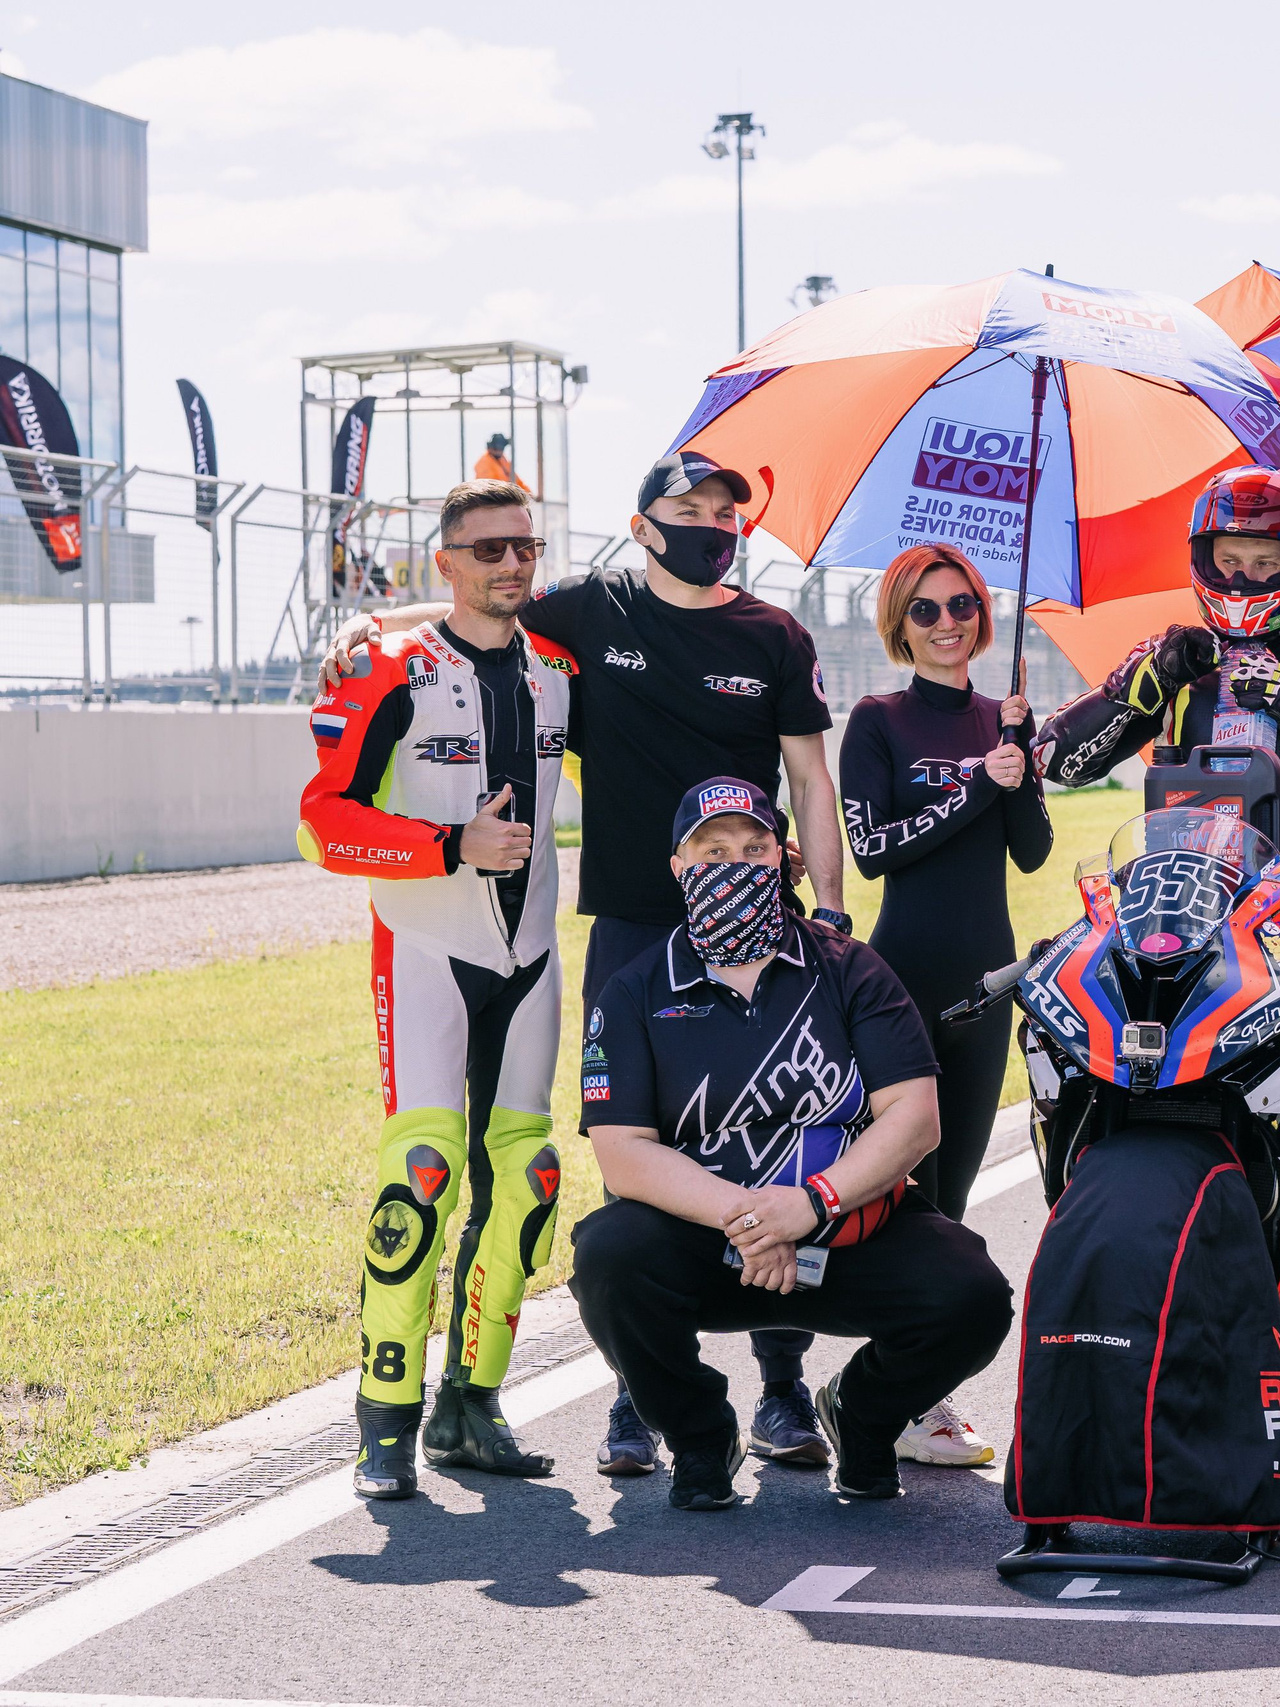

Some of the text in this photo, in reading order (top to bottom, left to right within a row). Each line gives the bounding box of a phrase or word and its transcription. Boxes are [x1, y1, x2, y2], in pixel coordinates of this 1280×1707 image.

[1050, 295, 1170, 330] MOLY
[410, 673, 435, 689] agv
[703, 675, 768, 697] RLS
[1214, 722, 1249, 744] Arctic
[703, 785, 746, 800] LIQUI
[704, 797, 748, 813] MOLY
[898, 785, 968, 846] FAST
[1215, 805, 1239, 813] LIQUI
[327, 842, 413, 863] FAST CREW
[355, 857, 381, 865] MOSCOW
[1117, 850, 1244, 925] 555
[711, 882, 756, 920] MOTORBIKE
[1038, 922, 1086, 967] MOTORING
[1028, 981, 1088, 1038] RLS
[583, 1075, 607, 1089] LIQUI
[583, 1087, 609, 1100] MOLY
[1040, 1333, 1131, 1348] RACEFOXX.COM
